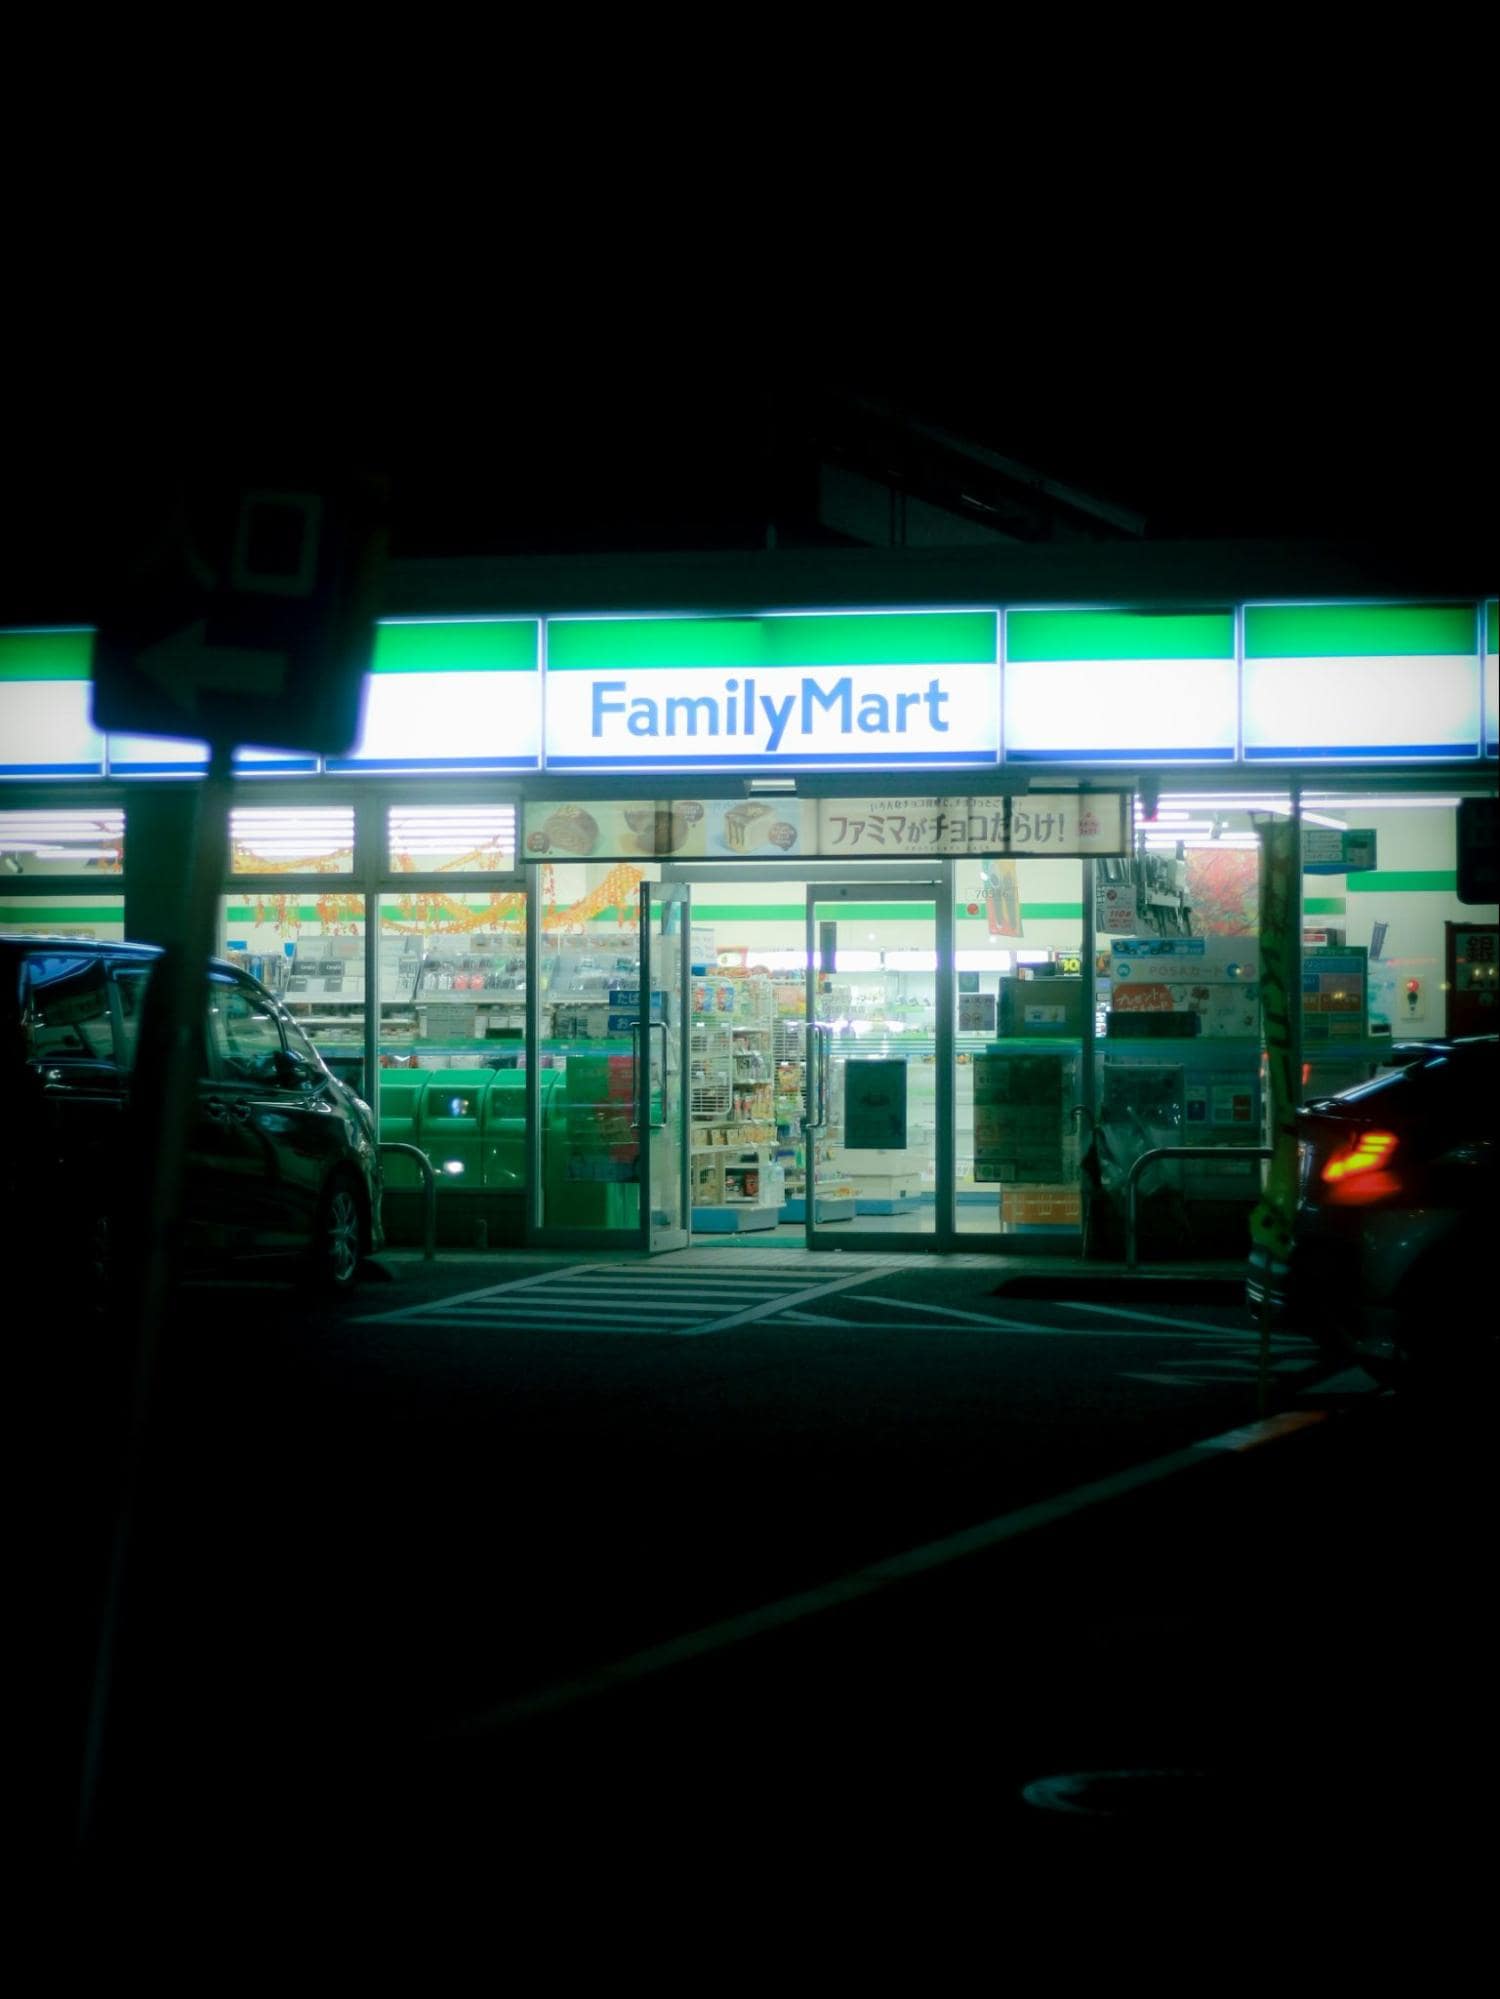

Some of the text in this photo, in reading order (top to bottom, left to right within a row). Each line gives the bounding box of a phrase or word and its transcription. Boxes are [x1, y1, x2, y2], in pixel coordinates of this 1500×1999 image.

[591, 677, 950, 752] FamilyMart
[829, 812, 1065, 845] ファミマがチョコだらけ!
